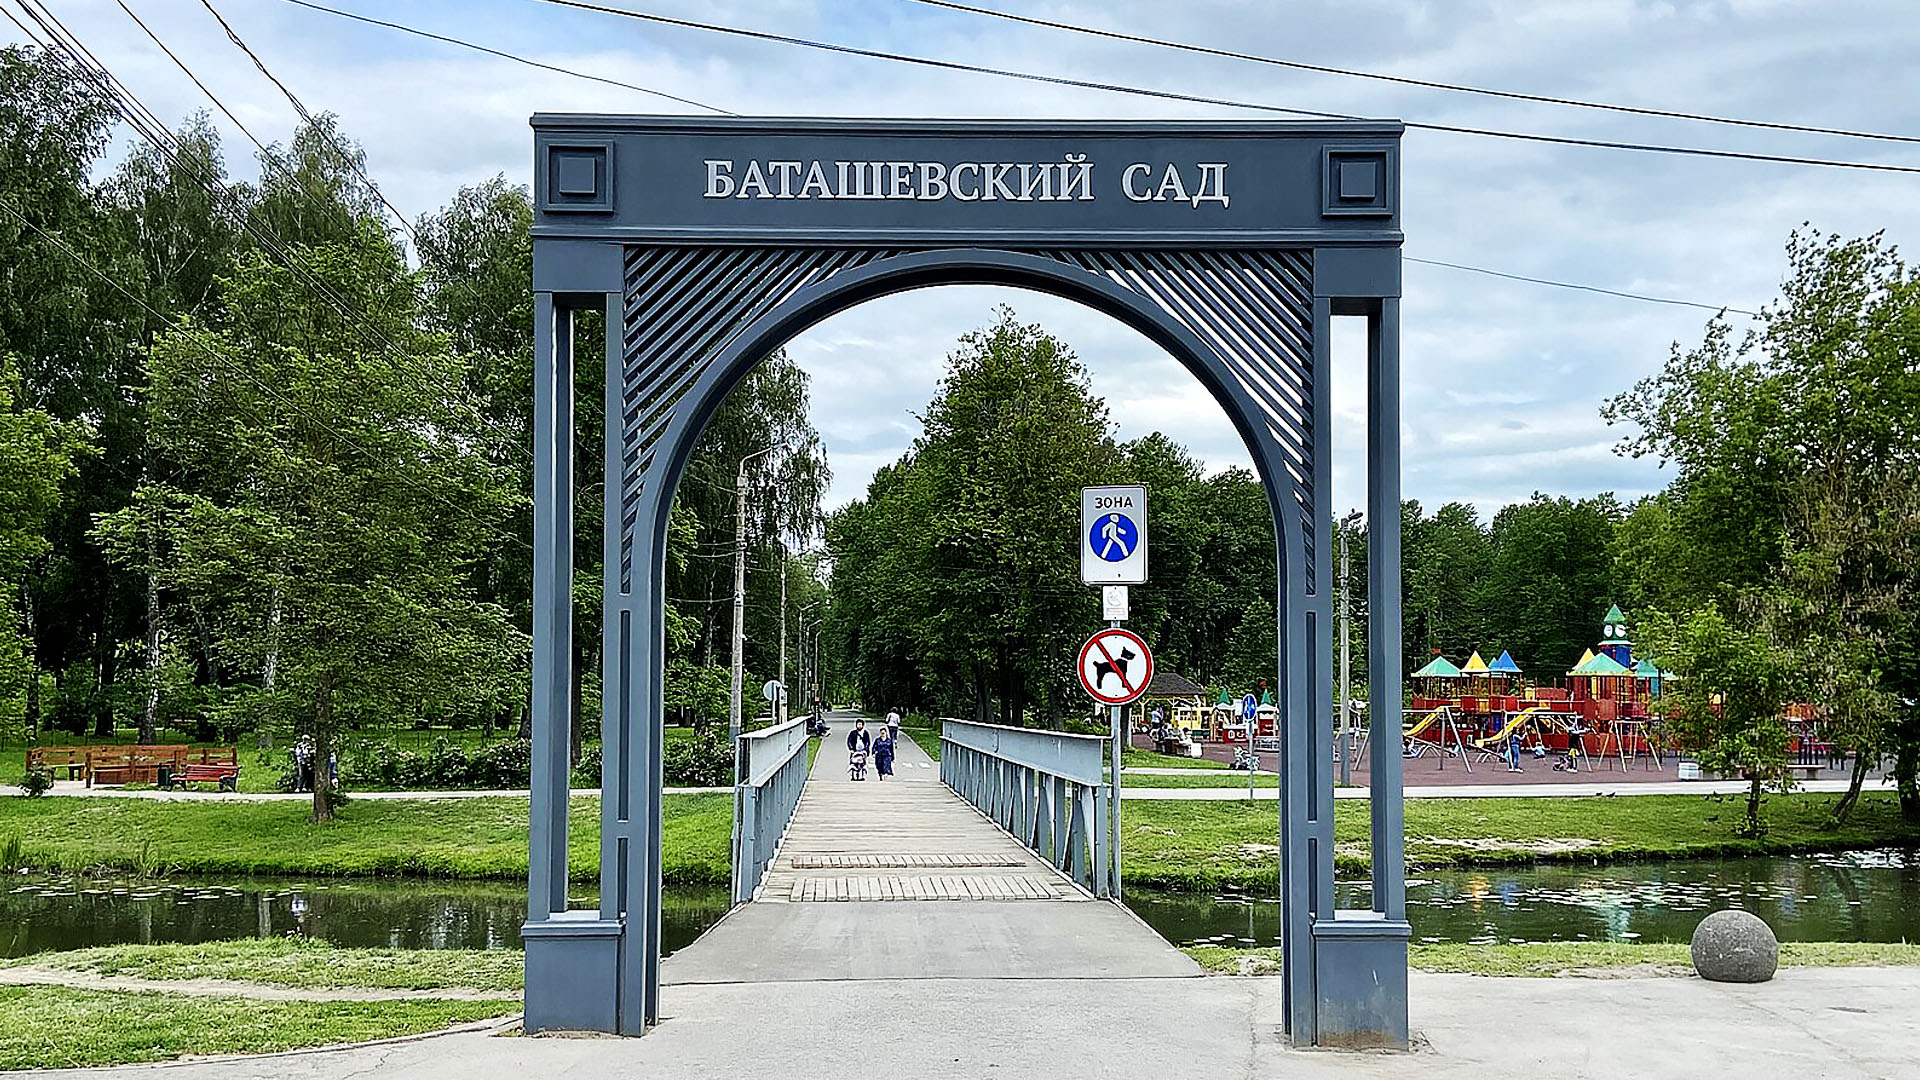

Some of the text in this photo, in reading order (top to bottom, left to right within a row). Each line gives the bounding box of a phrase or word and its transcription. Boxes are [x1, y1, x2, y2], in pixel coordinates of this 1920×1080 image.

[703, 153, 1230, 209] БАТАШЕВСКИЙ САД
[1094, 496, 1133, 509] ЗОНА
